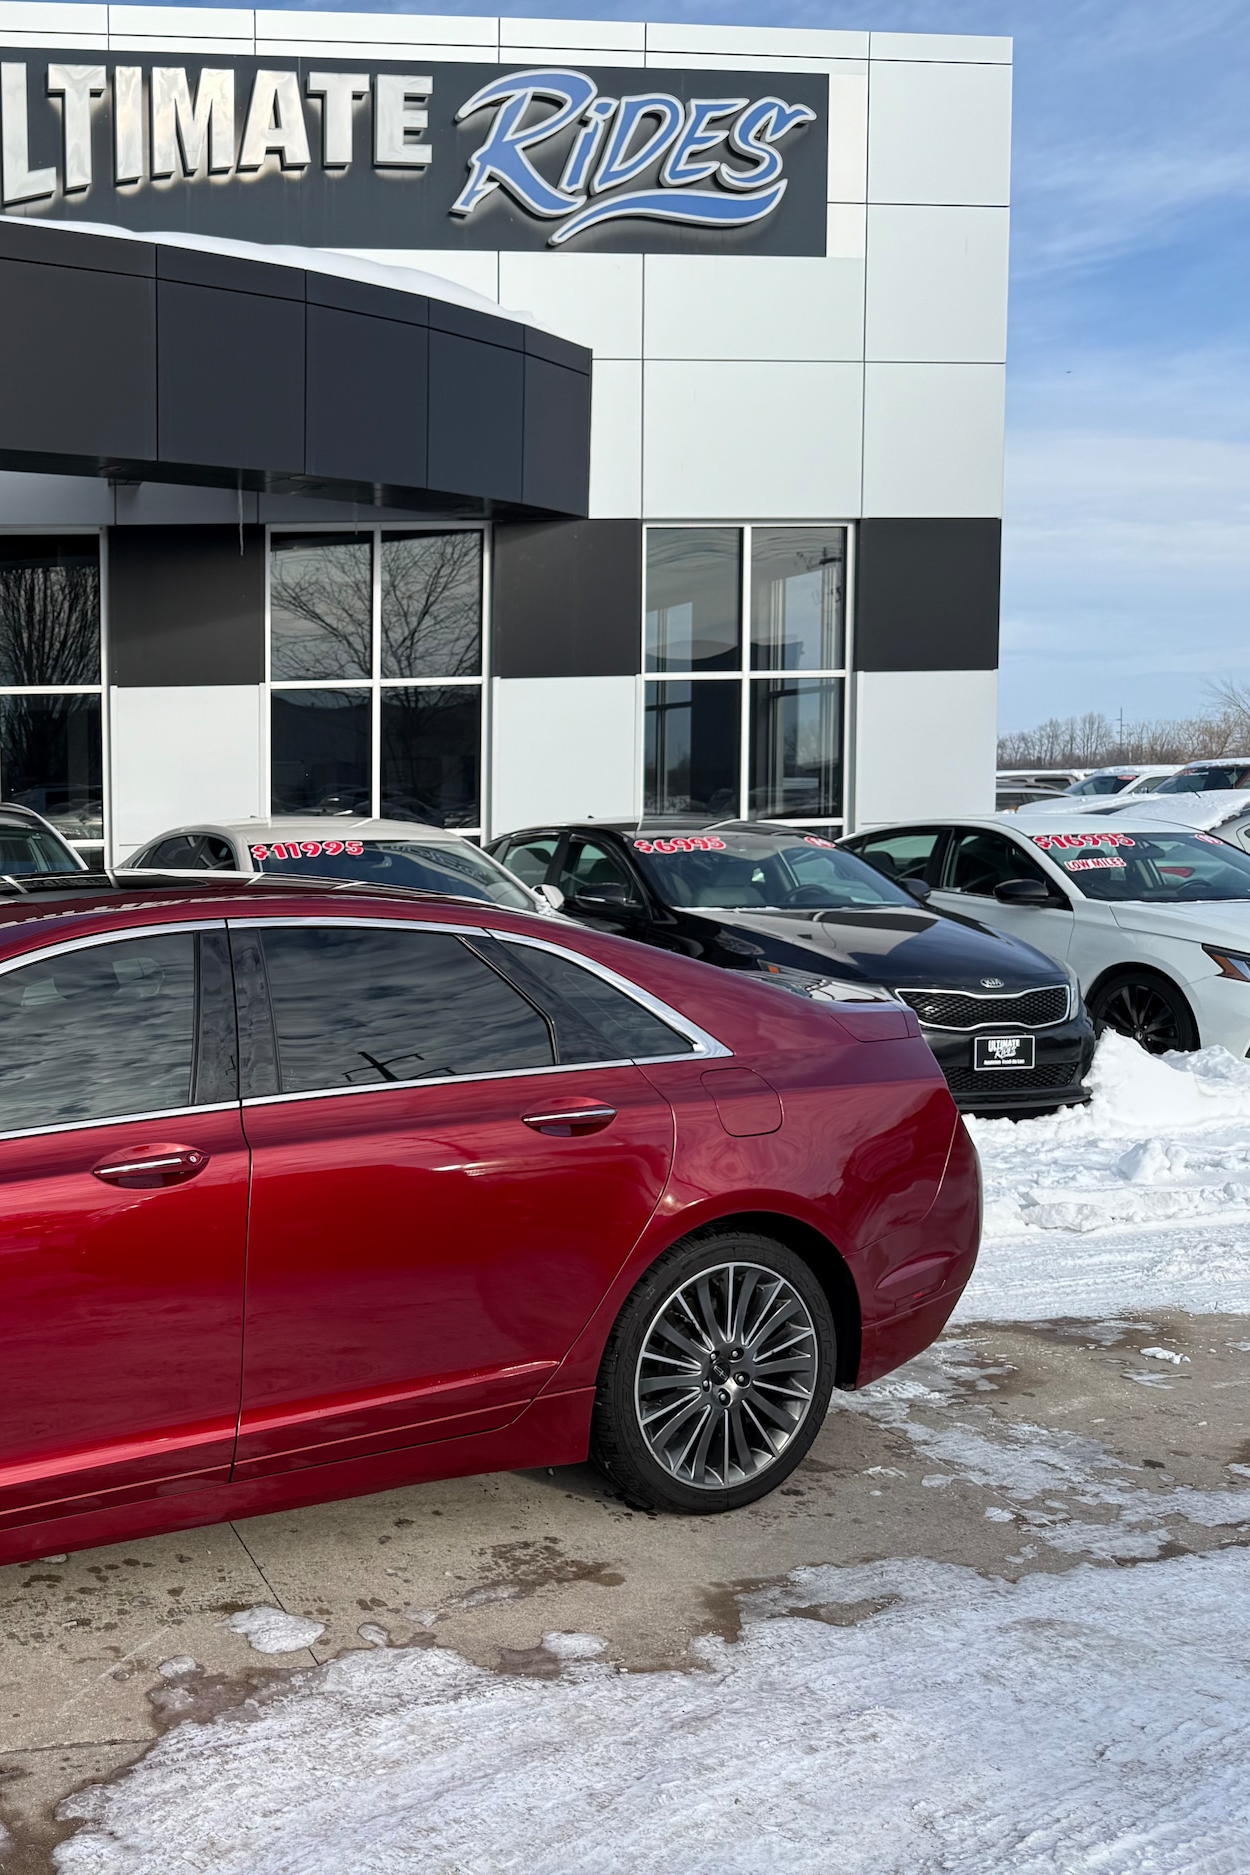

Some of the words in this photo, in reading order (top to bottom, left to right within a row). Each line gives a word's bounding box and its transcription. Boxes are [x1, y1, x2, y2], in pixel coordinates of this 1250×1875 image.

[634, 836, 727, 854] $6995
[1033, 833, 1136, 850] $16995
[250, 841, 364, 860] $11995
[1064, 860, 1090, 871] LOW
[1091, 857, 1127, 868] MILES
[988, 1039, 1020, 1053] ULTIMATE
